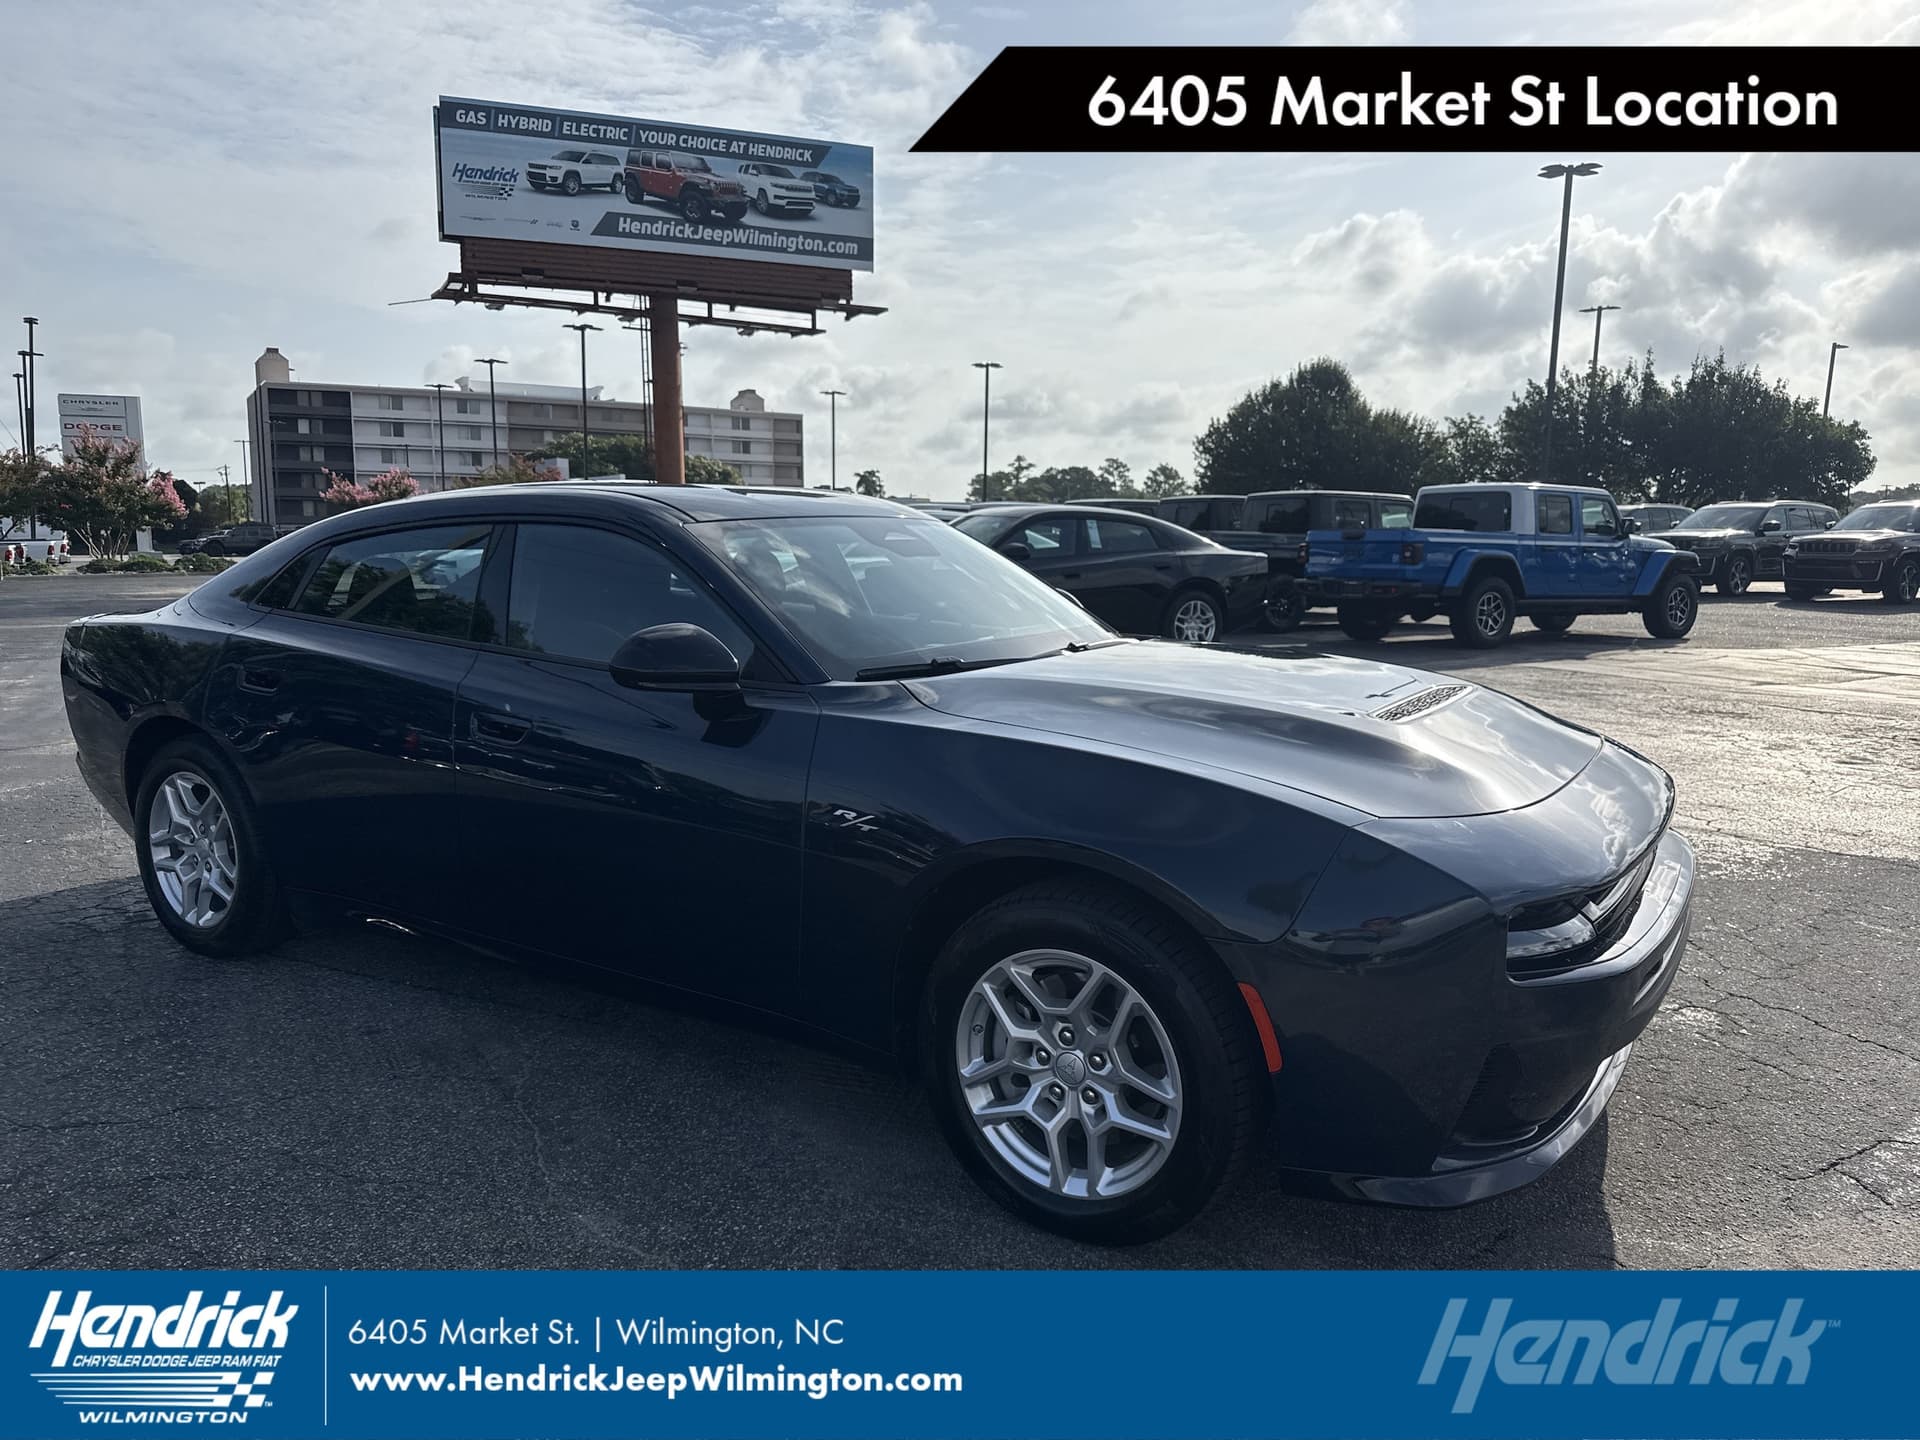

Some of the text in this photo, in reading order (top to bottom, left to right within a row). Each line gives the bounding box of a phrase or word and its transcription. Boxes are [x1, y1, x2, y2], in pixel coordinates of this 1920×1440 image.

[455, 109, 813, 163] GAS HYBRID ELECTRIC YOUR CHOICE AT HENDRICK
[452, 162, 520, 183] Hendrick
[618, 216, 859, 256] HendrickJeepWilmington.com
[832, 809, 880, 832] R/T
